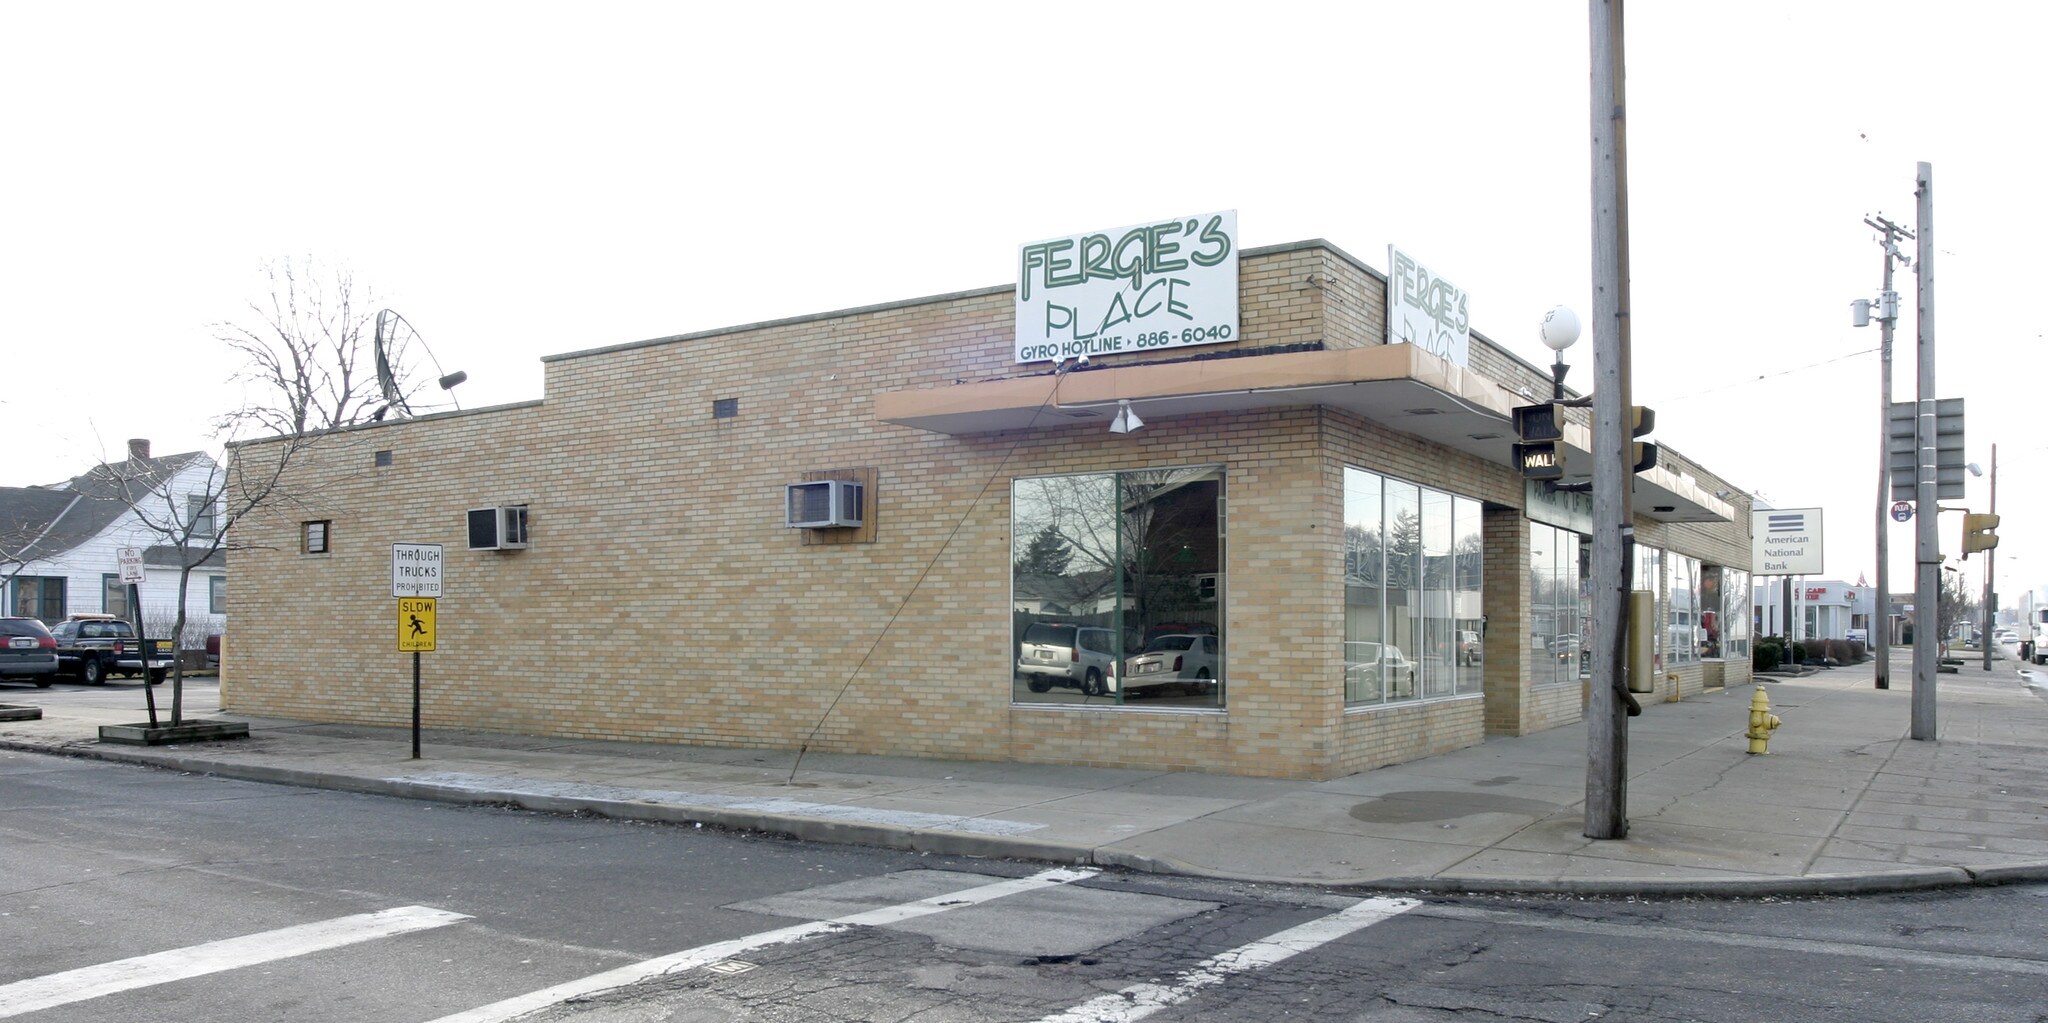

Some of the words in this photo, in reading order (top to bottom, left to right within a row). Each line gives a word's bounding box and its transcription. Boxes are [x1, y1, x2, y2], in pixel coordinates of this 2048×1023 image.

[1022, 214, 1231, 301] FERGIE'S
[1394, 250, 1469, 335] FERGIE'S
[1046, 277, 1193, 340] PLACE
[1020, 343, 1059, 360] GYRO
[1062, 335, 1122, 355] HOTLINE
[1764, 535, 1809, 545] American
[124, 549, 135, 558] NO
[396, 549, 440, 562] THROUGH
[1764, 547, 1804, 557] National
[1764, 561, 1788, 571] Bank
[399, 566, 437, 578] TRUCKS
[396, 582, 440, 592] PROHIBITED
[402, 602, 433, 612] SLOW
